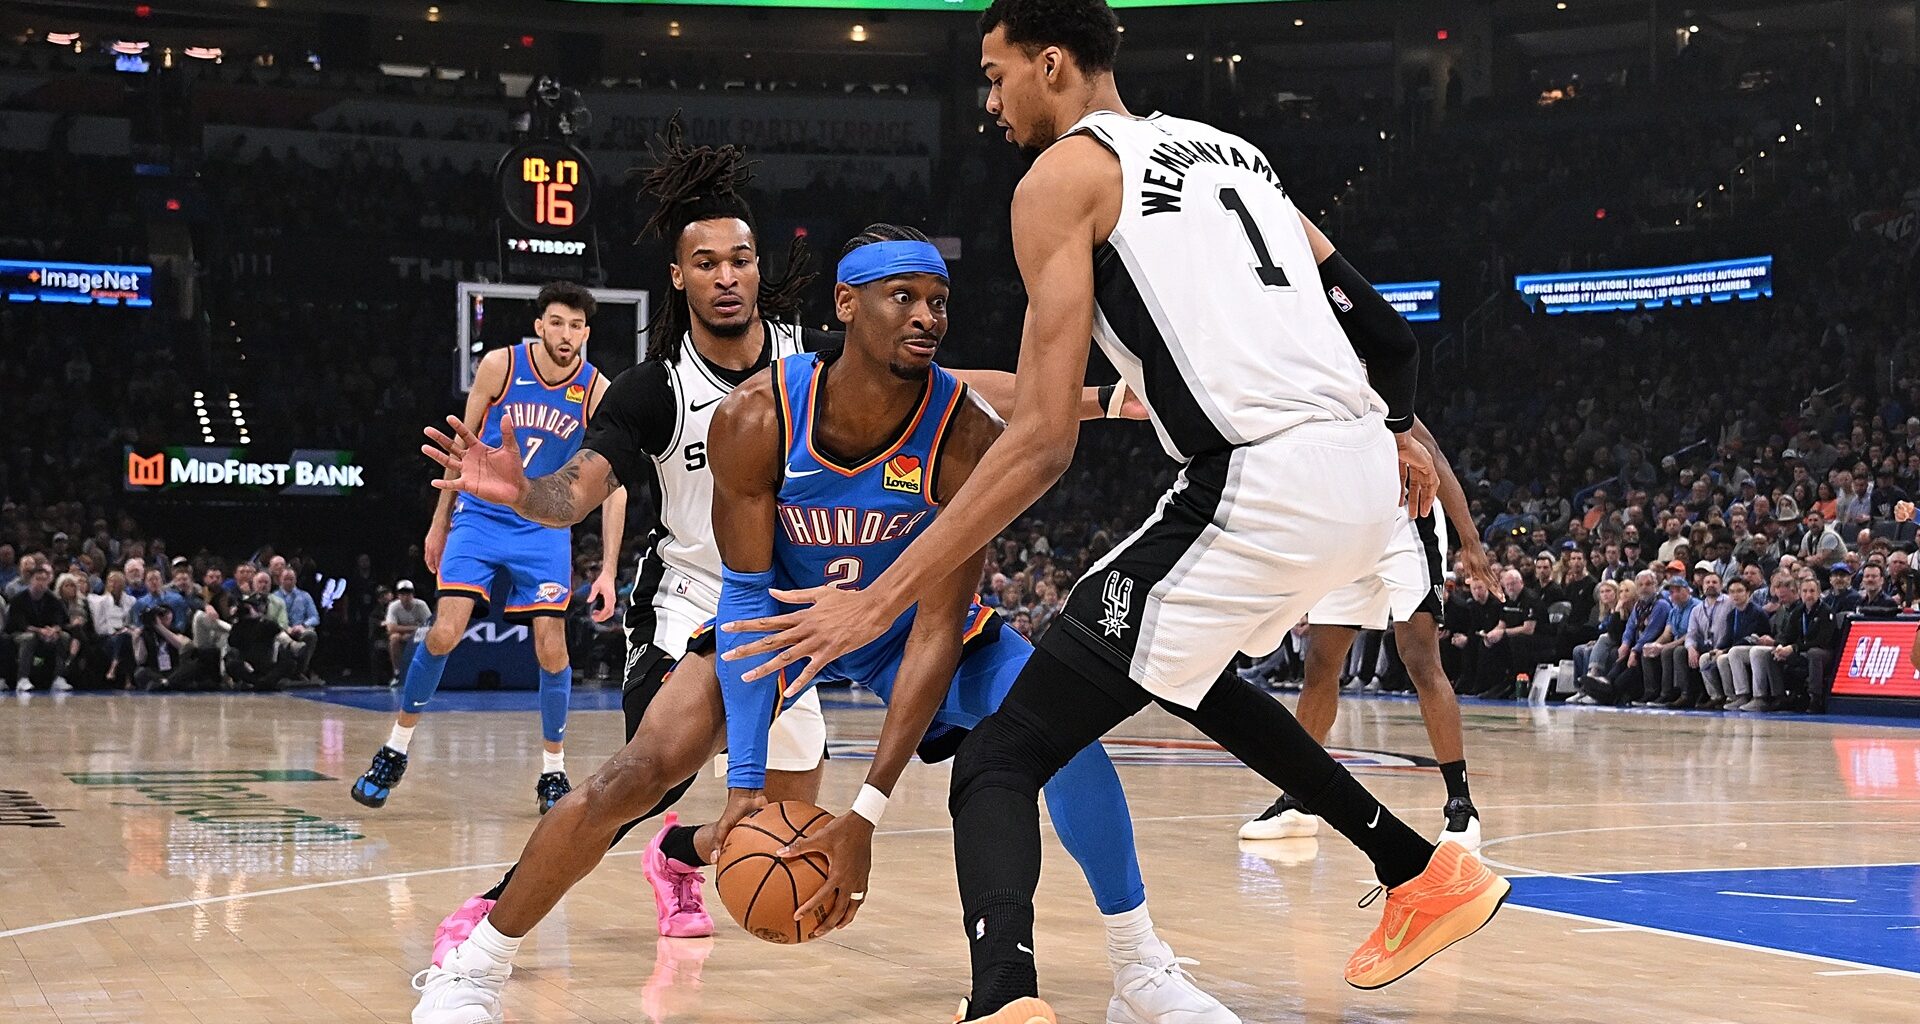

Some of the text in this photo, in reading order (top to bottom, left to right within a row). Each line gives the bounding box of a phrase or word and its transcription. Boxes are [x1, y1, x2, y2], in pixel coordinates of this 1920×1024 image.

[522, 157, 579, 185] 10:17
[536, 182, 575, 226] 16
[529, 239, 586, 255] TISSOT
[1217, 187, 1293, 288] 1
[41, 268, 139, 293] ImageNet
[1524, 283, 1553, 294] OFFICE
[1554, 281, 1580, 293] PRINT
[1581, 279, 1628, 291] SOLUTIONS
[1633, 275, 1676, 289] DOCUMENT
[1683, 271, 1716, 284] PROCESS
[1717, 266, 1766, 280] AUTOMATION
[1581, 292, 1590, 302] IT
[1595, 288, 1653, 302] AUDIO/VISUAL
[1658, 287, 1668, 297] 3D
[1668, 284, 1704, 297] PRINTERS
[1711, 279, 1751, 292] SCANNERS
[504, 403, 580, 439] THUNDER
[523, 437, 544, 468] 7
[295, 460, 364, 487] BANK
[825, 556, 863, 592] 2
[1861, 637, 1900, 685] App
